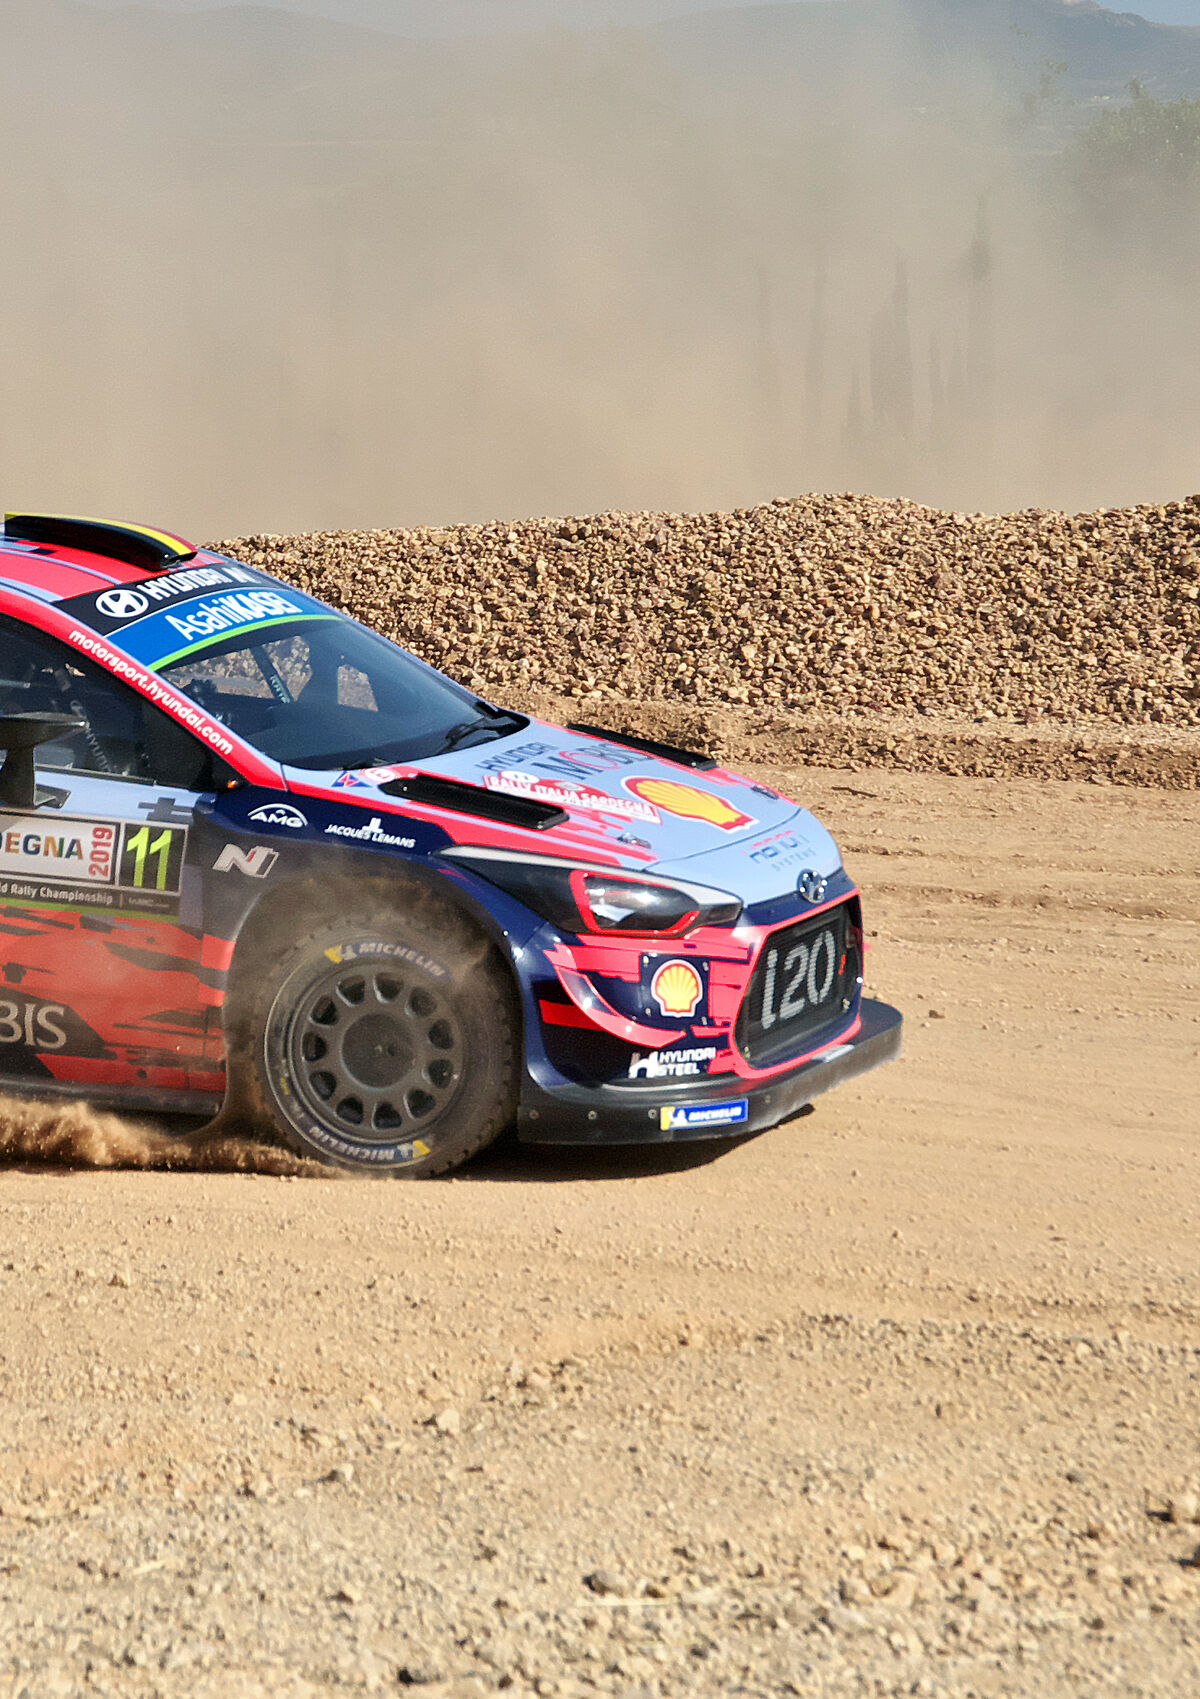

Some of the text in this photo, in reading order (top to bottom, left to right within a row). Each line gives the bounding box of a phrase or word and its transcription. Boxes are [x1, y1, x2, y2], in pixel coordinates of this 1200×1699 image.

[136, 567, 232, 601] HYUNDAI
[165, 591, 304, 641] AsahiKASEI
[68, 630, 233, 755] motorsport.hyundai.com
[489, 775, 533, 791] RALLY
[534, 784, 581, 799] ITALIA
[580, 791, 659, 818] SARDEGNA
[249, 811, 303, 829] AMG
[324, 823, 416, 848] JACQUES LEMANS
[88, 826, 113, 878] 2019
[126, 826, 173, 891] 11
[10, 883, 38, 899] Rally
[39, 886, 113, 905] Championship
[358, 942, 446, 977] MICHELIN
[656, 1062, 701, 1077] STEEL
[659, 1046, 717, 1064] HYUNDAI
[688, 1106, 743, 1121] MICHELIN
